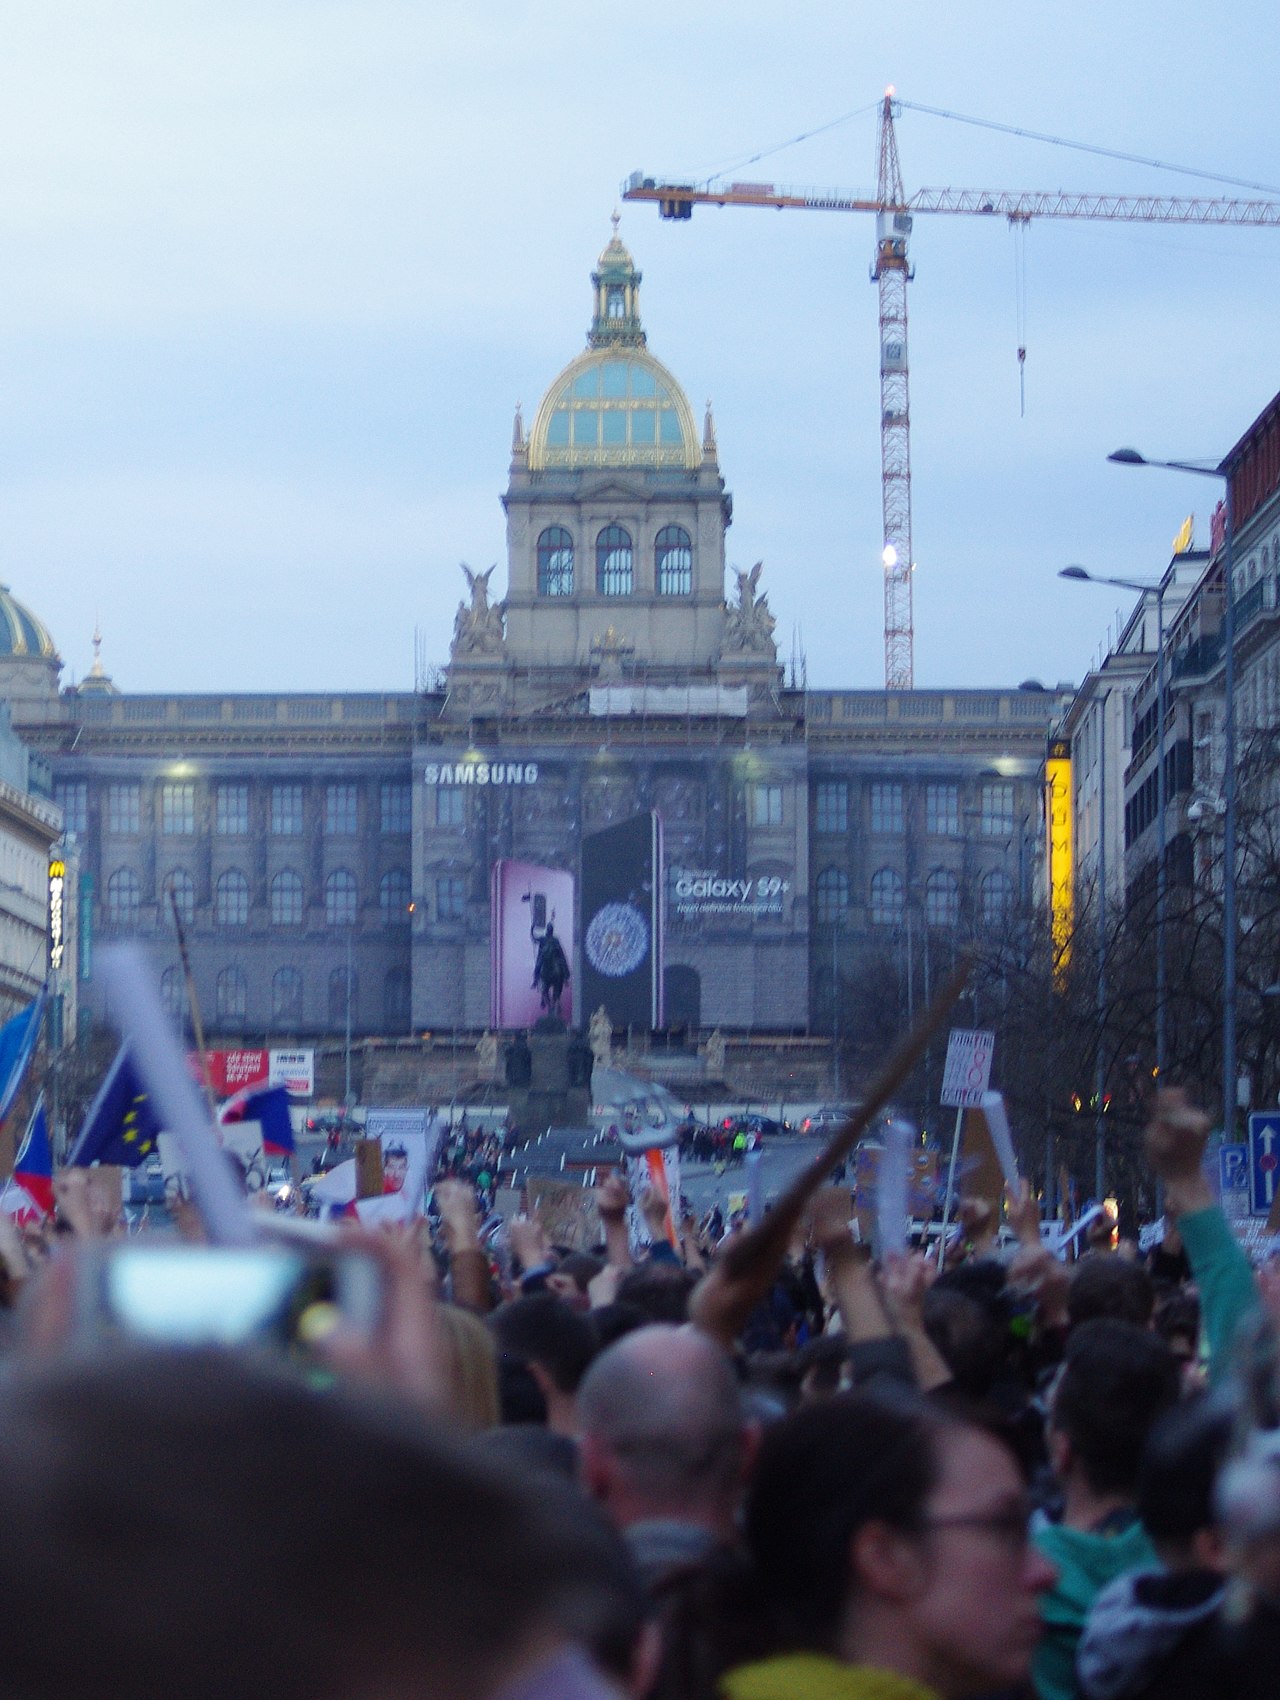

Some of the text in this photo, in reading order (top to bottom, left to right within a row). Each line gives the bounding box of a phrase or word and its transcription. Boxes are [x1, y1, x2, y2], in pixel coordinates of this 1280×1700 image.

[424, 762, 539, 785] SAMSUNG
[675, 876, 791, 902] Galaxy S9+
[1224, 1150, 1243, 1178] P
